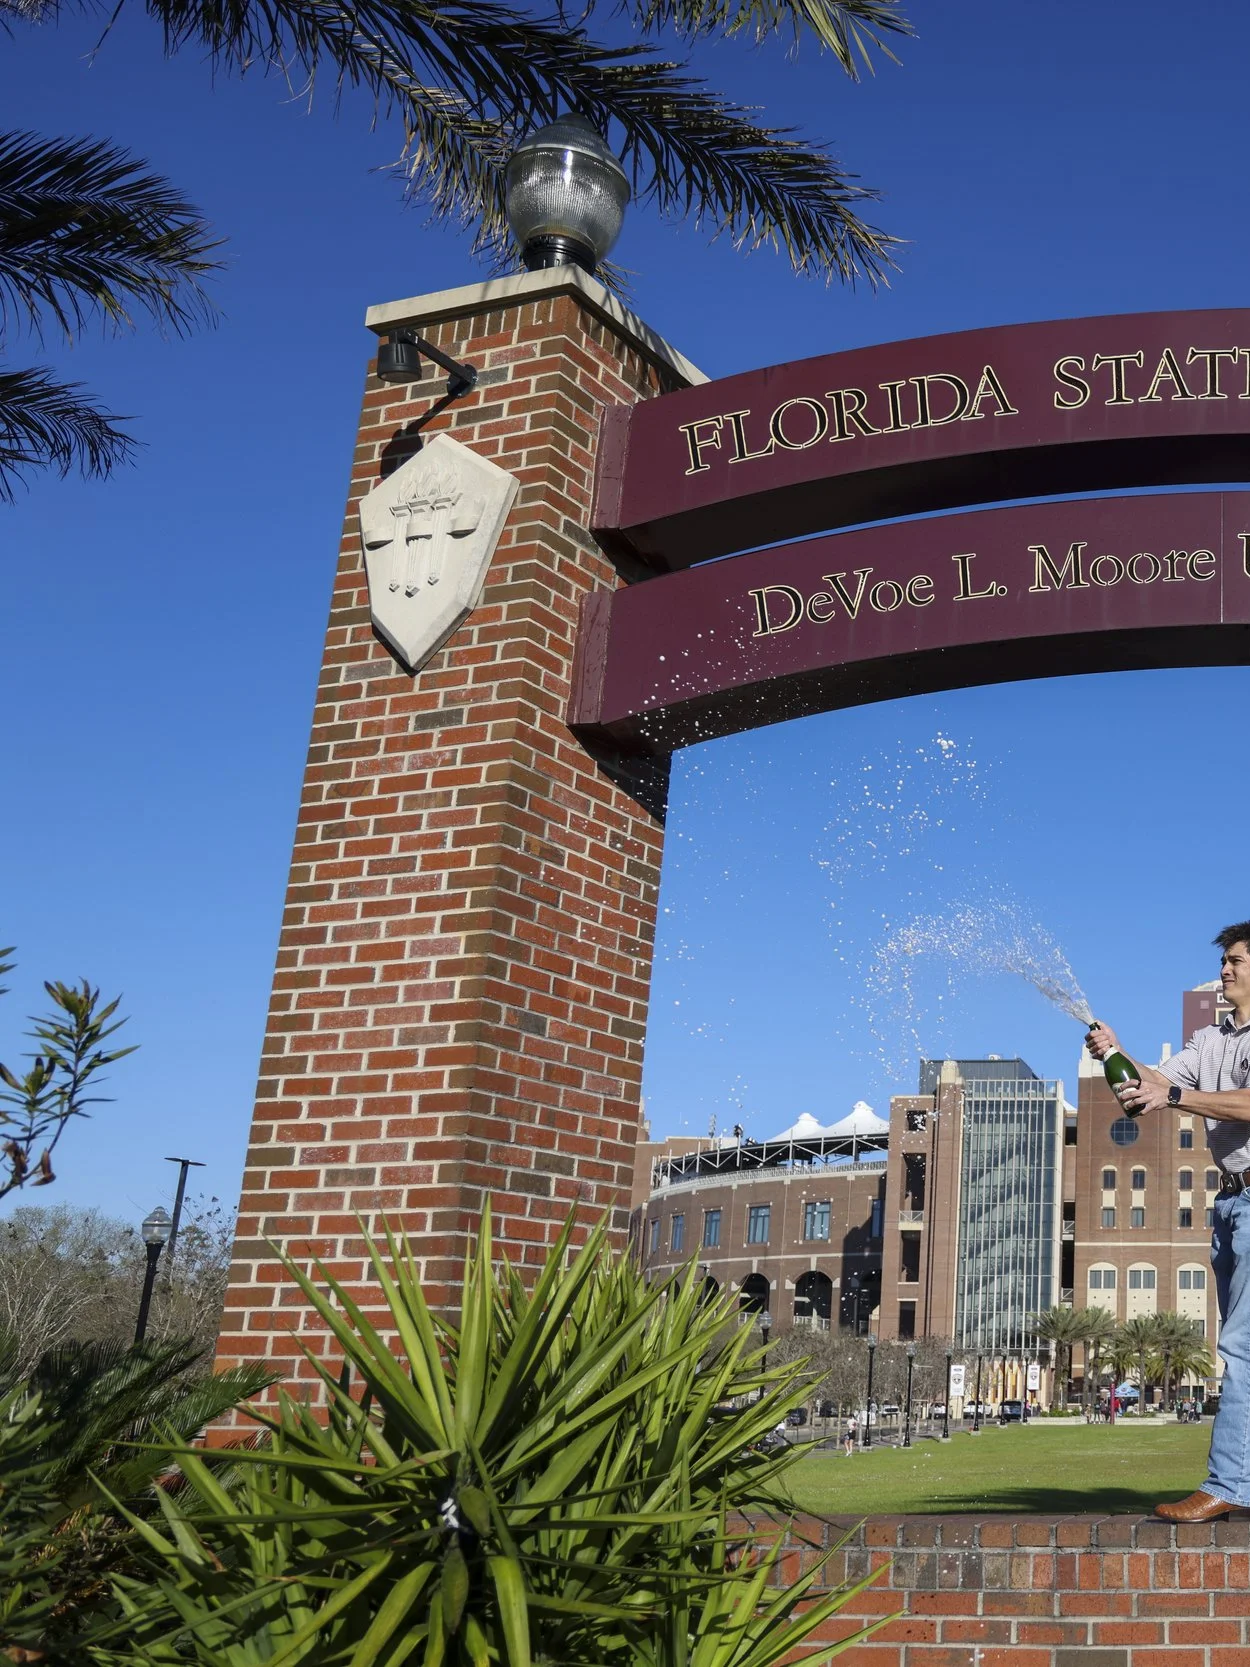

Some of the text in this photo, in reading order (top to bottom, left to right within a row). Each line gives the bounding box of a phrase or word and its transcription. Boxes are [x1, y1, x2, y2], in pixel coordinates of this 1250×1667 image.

[679, 365, 1018, 475] FLORIDA
[749, 568, 935, 637] DeVoe
[952, 553, 1007, 601] L.
[1028, 541, 1216, 592] Moore
